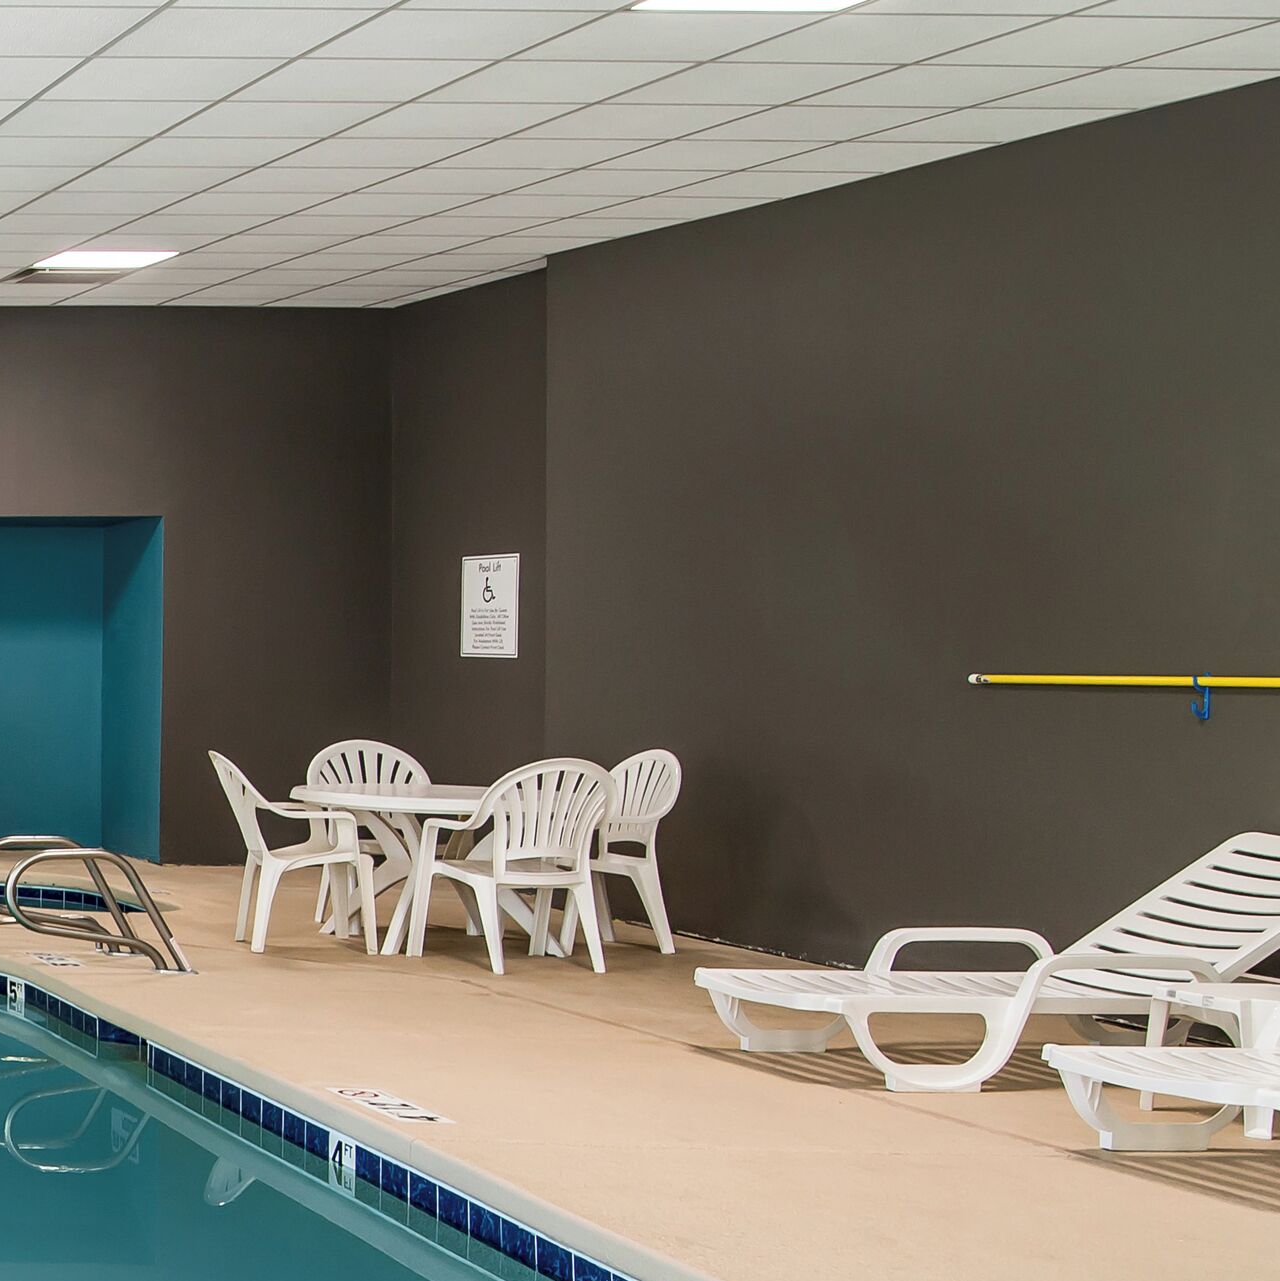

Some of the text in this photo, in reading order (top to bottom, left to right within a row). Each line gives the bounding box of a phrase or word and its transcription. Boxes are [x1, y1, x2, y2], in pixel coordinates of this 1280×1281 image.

[479, 560, 502, 573] Pool Lift
[10, 980, 17, 1003] 5
[332, 1140, 353, 1166] 4 FT
